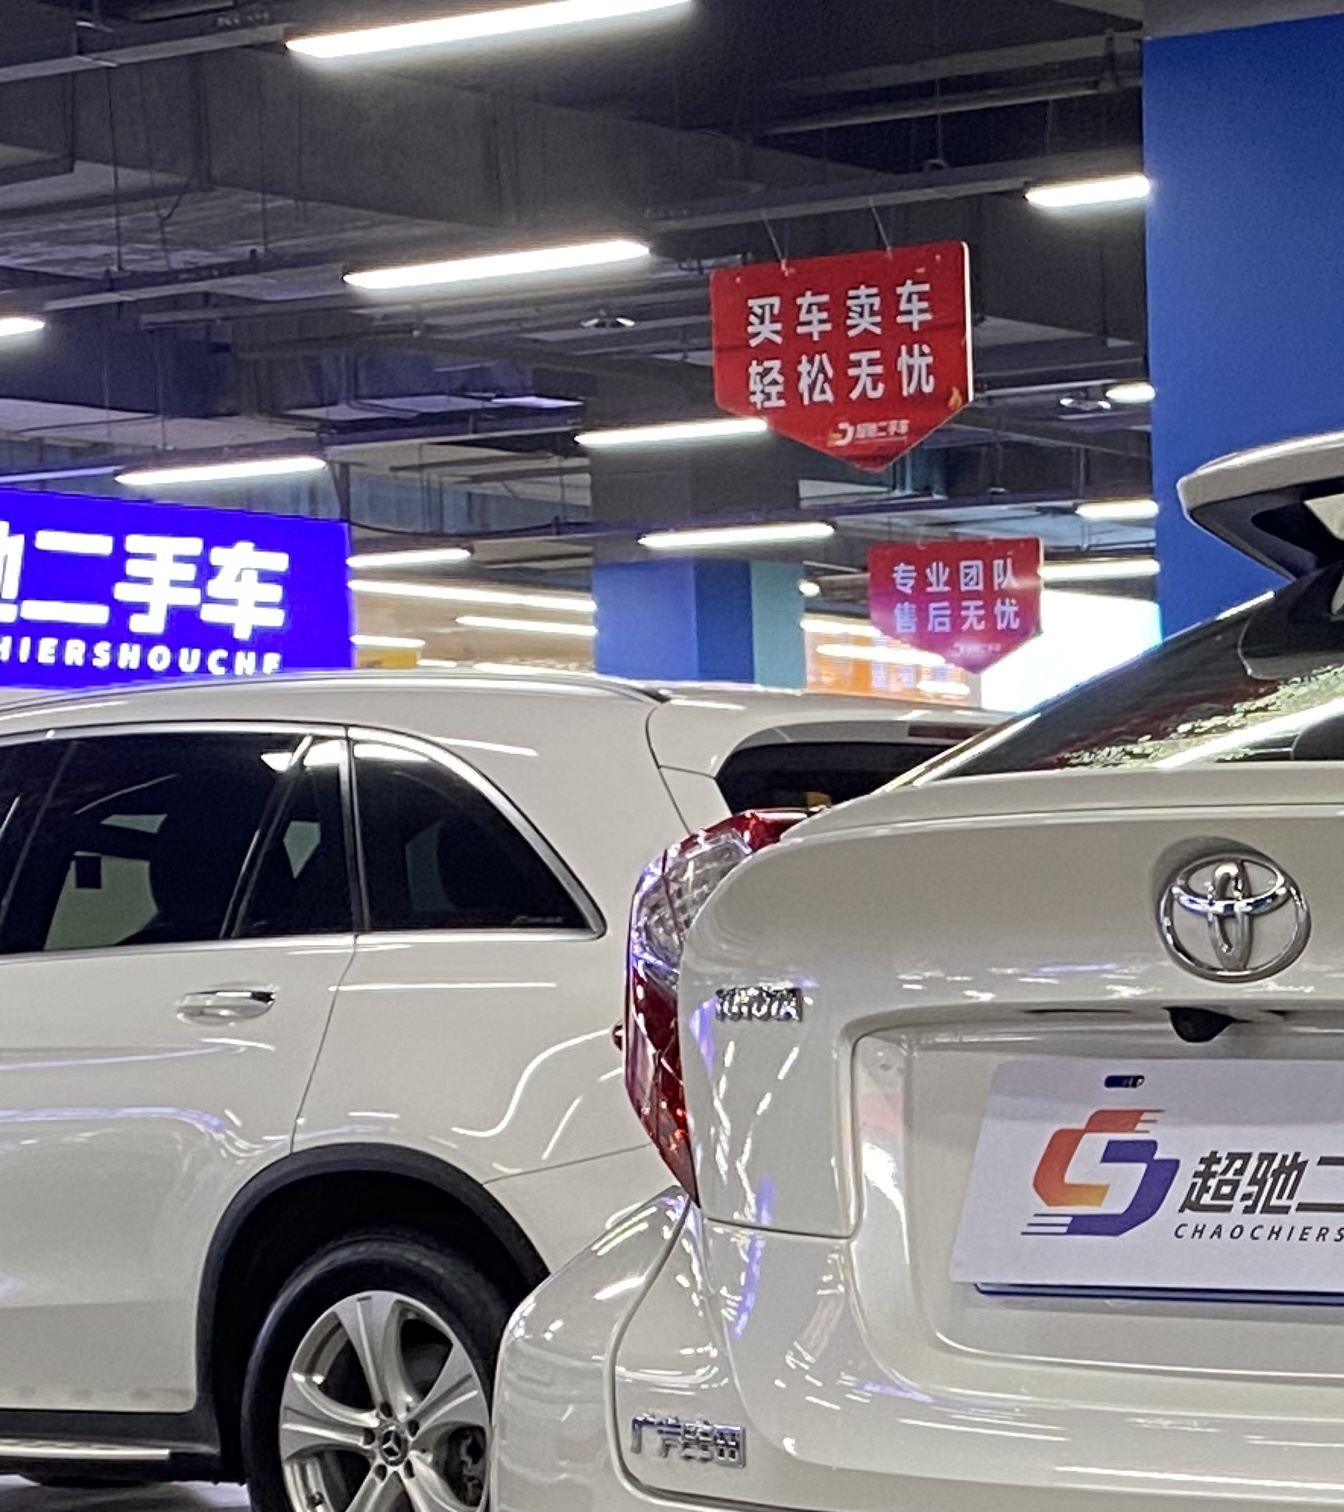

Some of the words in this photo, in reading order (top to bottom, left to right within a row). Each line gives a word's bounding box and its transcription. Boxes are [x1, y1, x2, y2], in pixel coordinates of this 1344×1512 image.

[746, 279, 933, 348] 买车卖车
[748, 344, 935, 411] 轻松无忧
[892, 558, 1019, 595] 专业团队
[893, 598, 1021, 634] 售后无忧
